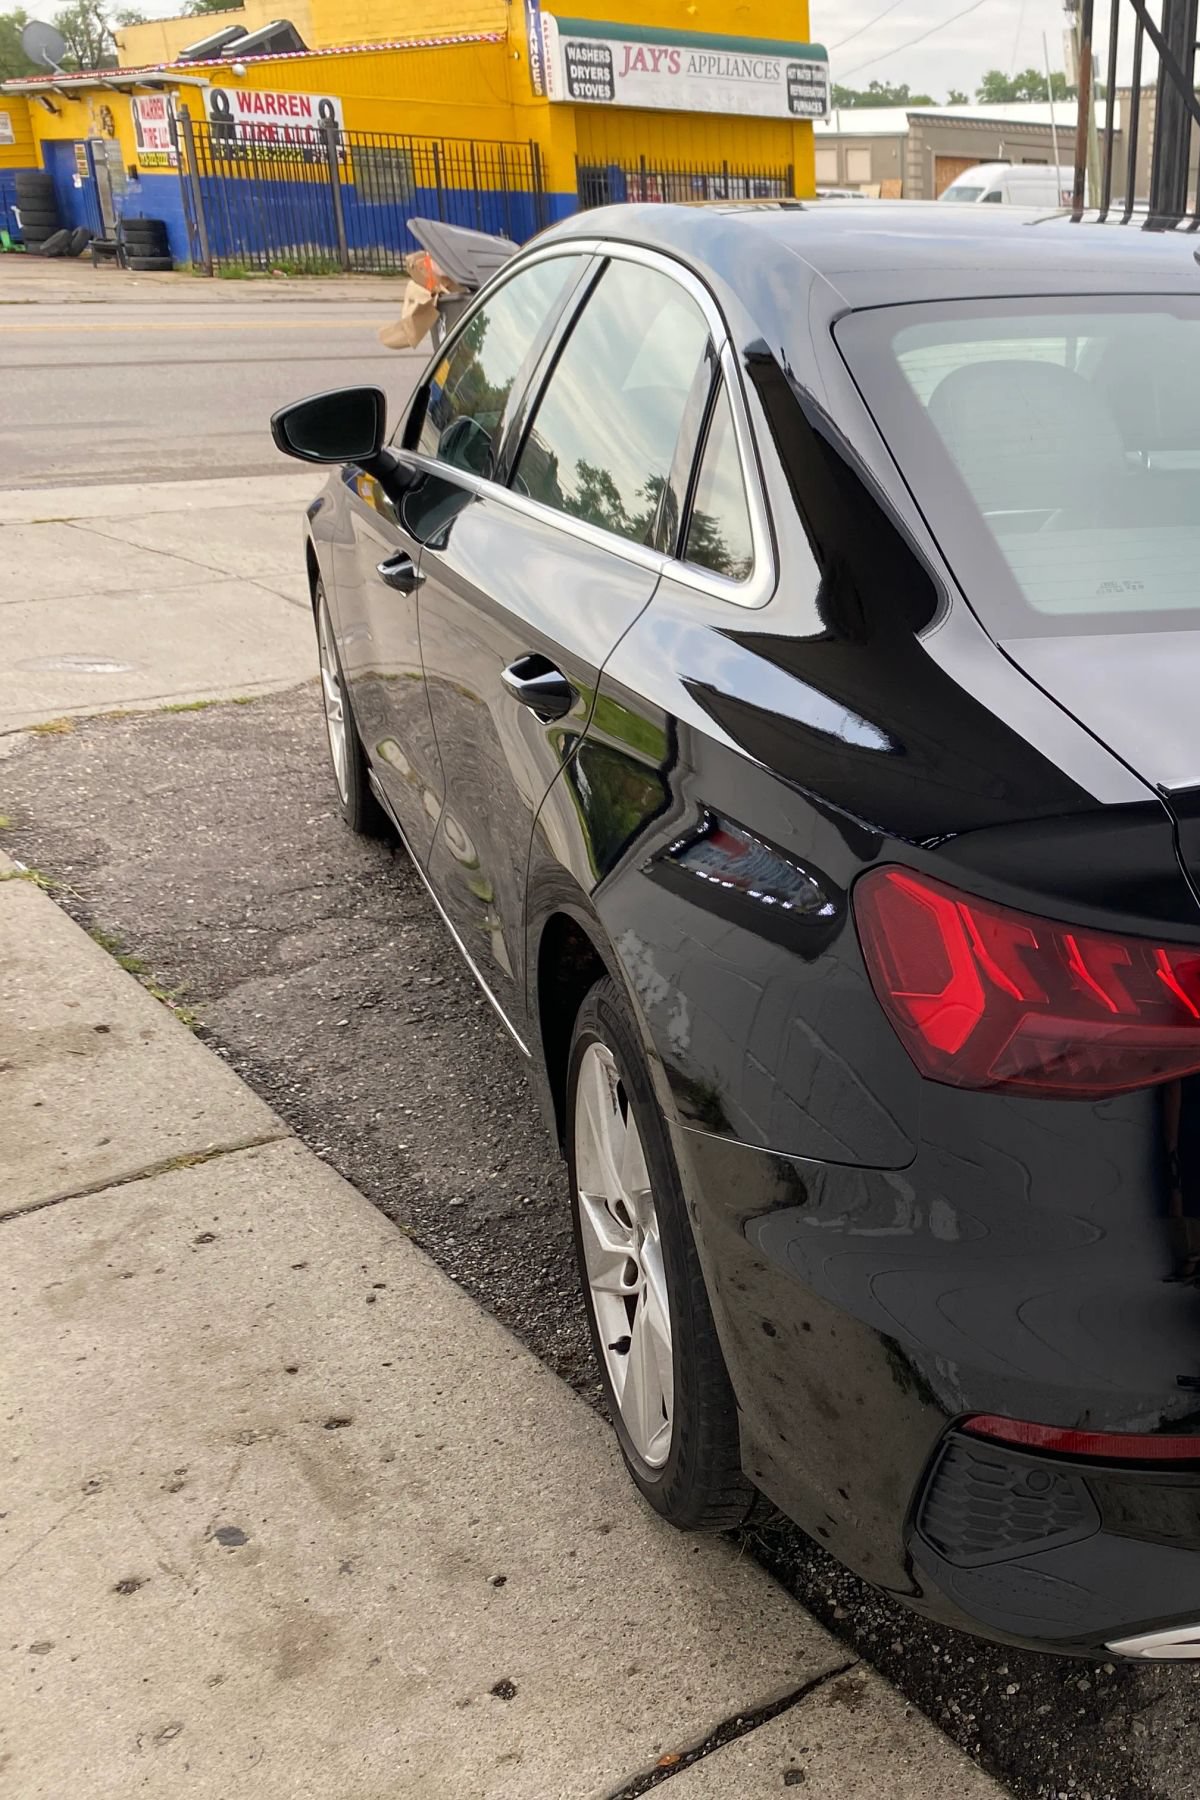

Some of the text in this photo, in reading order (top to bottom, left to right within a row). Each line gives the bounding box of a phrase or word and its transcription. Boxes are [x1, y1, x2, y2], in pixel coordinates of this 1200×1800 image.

[567, 47, 611, 63] WASHERS
[619, 46, 781, 81] JAY'S APPLIANCES
[570, 65, 611, 81] DRYERS
[573, 82, 611, 98] STOVES
[236, 91, 312, 117] WARREN
